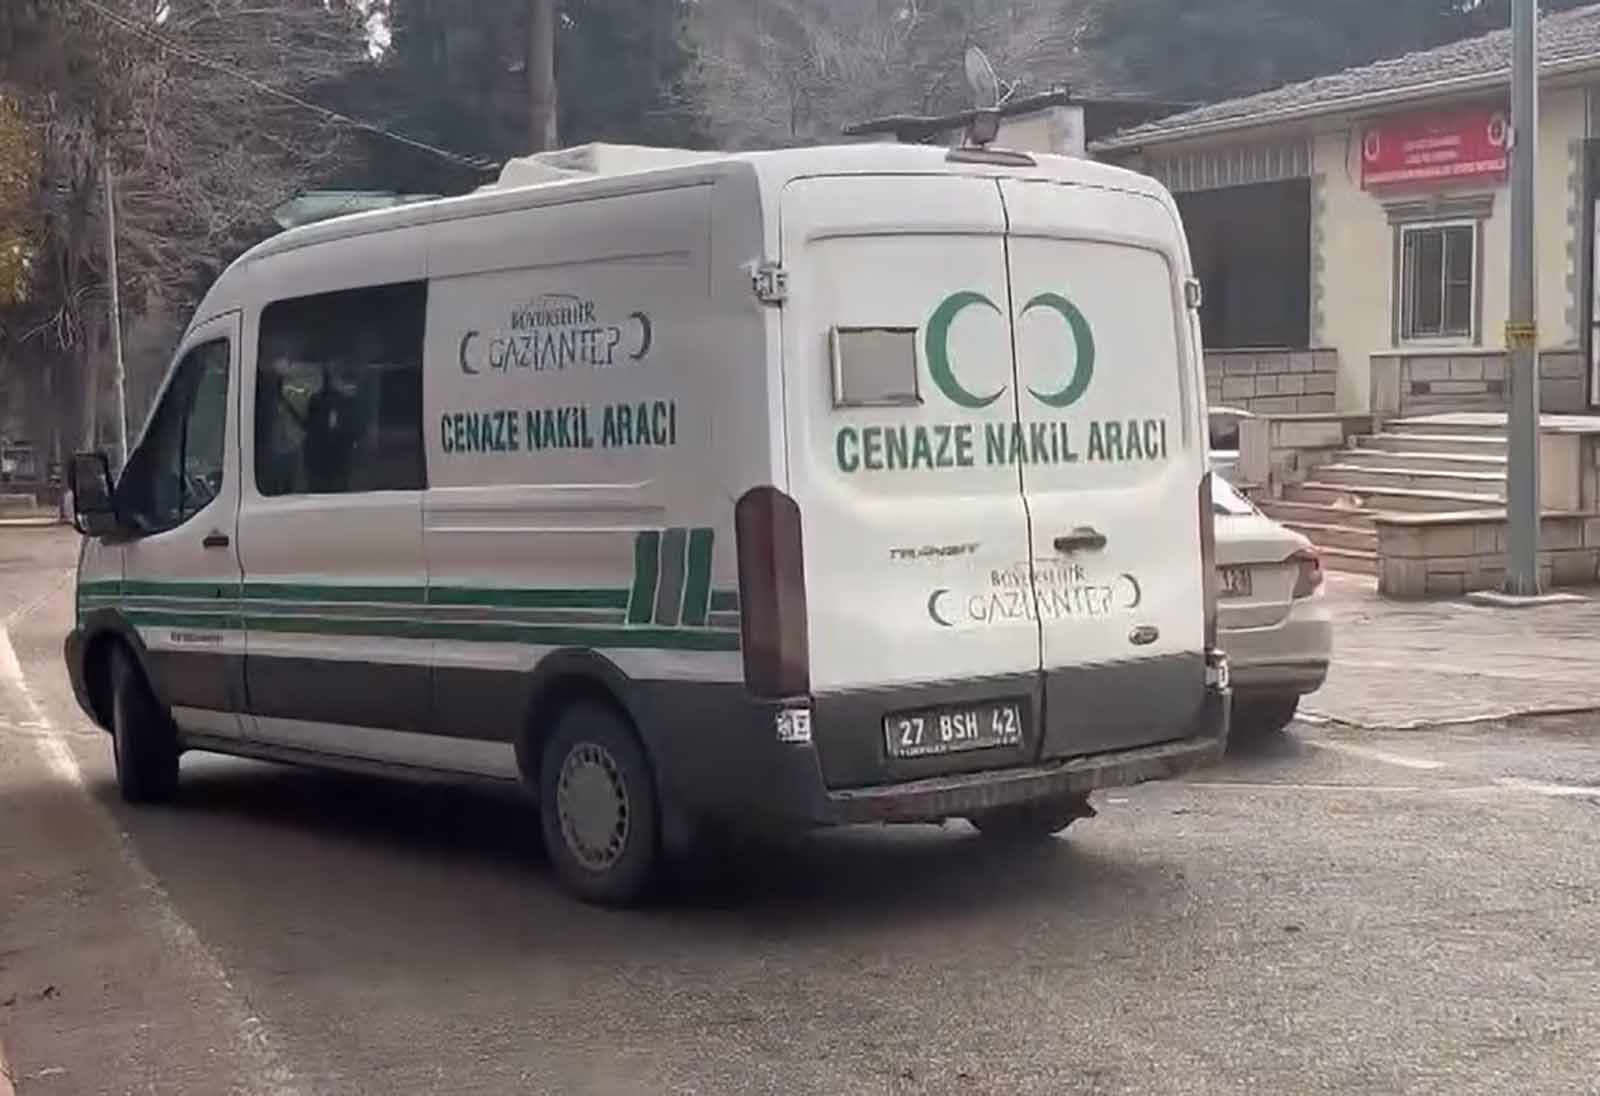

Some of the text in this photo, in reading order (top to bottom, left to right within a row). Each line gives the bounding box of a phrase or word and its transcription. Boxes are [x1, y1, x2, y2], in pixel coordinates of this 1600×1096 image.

[441, 411, 519, 454] CENAZE
[602, 400, 677, 447] ARACI
[836, 424, 975, 473] CENAZE
[1087, 419, 1167, 460] ARACI
[900, 707, 1016, 745] 27 BSH 42
